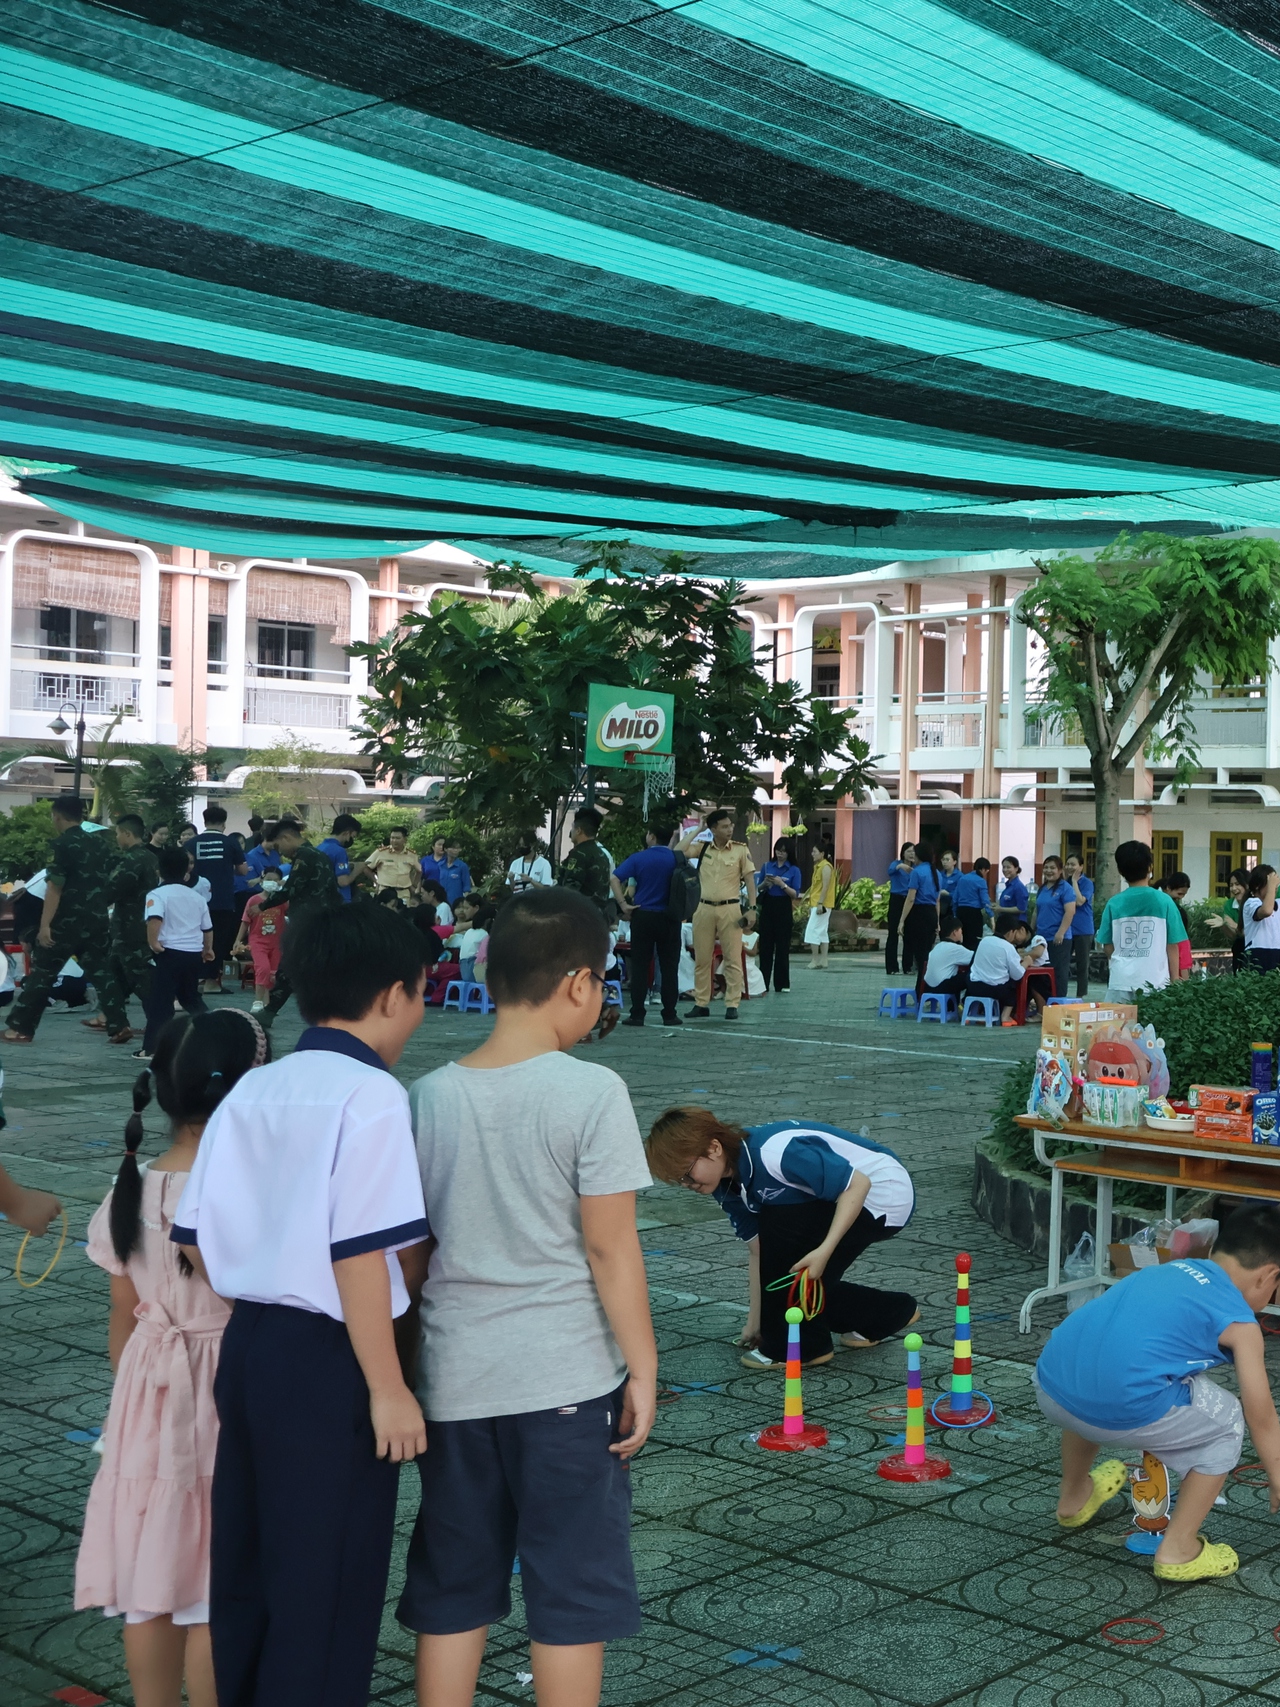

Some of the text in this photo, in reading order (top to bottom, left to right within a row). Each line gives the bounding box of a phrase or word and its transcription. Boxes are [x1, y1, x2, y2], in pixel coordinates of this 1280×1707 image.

[635, 710, 658, 719] Nestlé
[606, 718, 659, 740] MILO
[1120, 920, 1155, 949] 66
[1255, 1098, 1277, 1107] OREO
